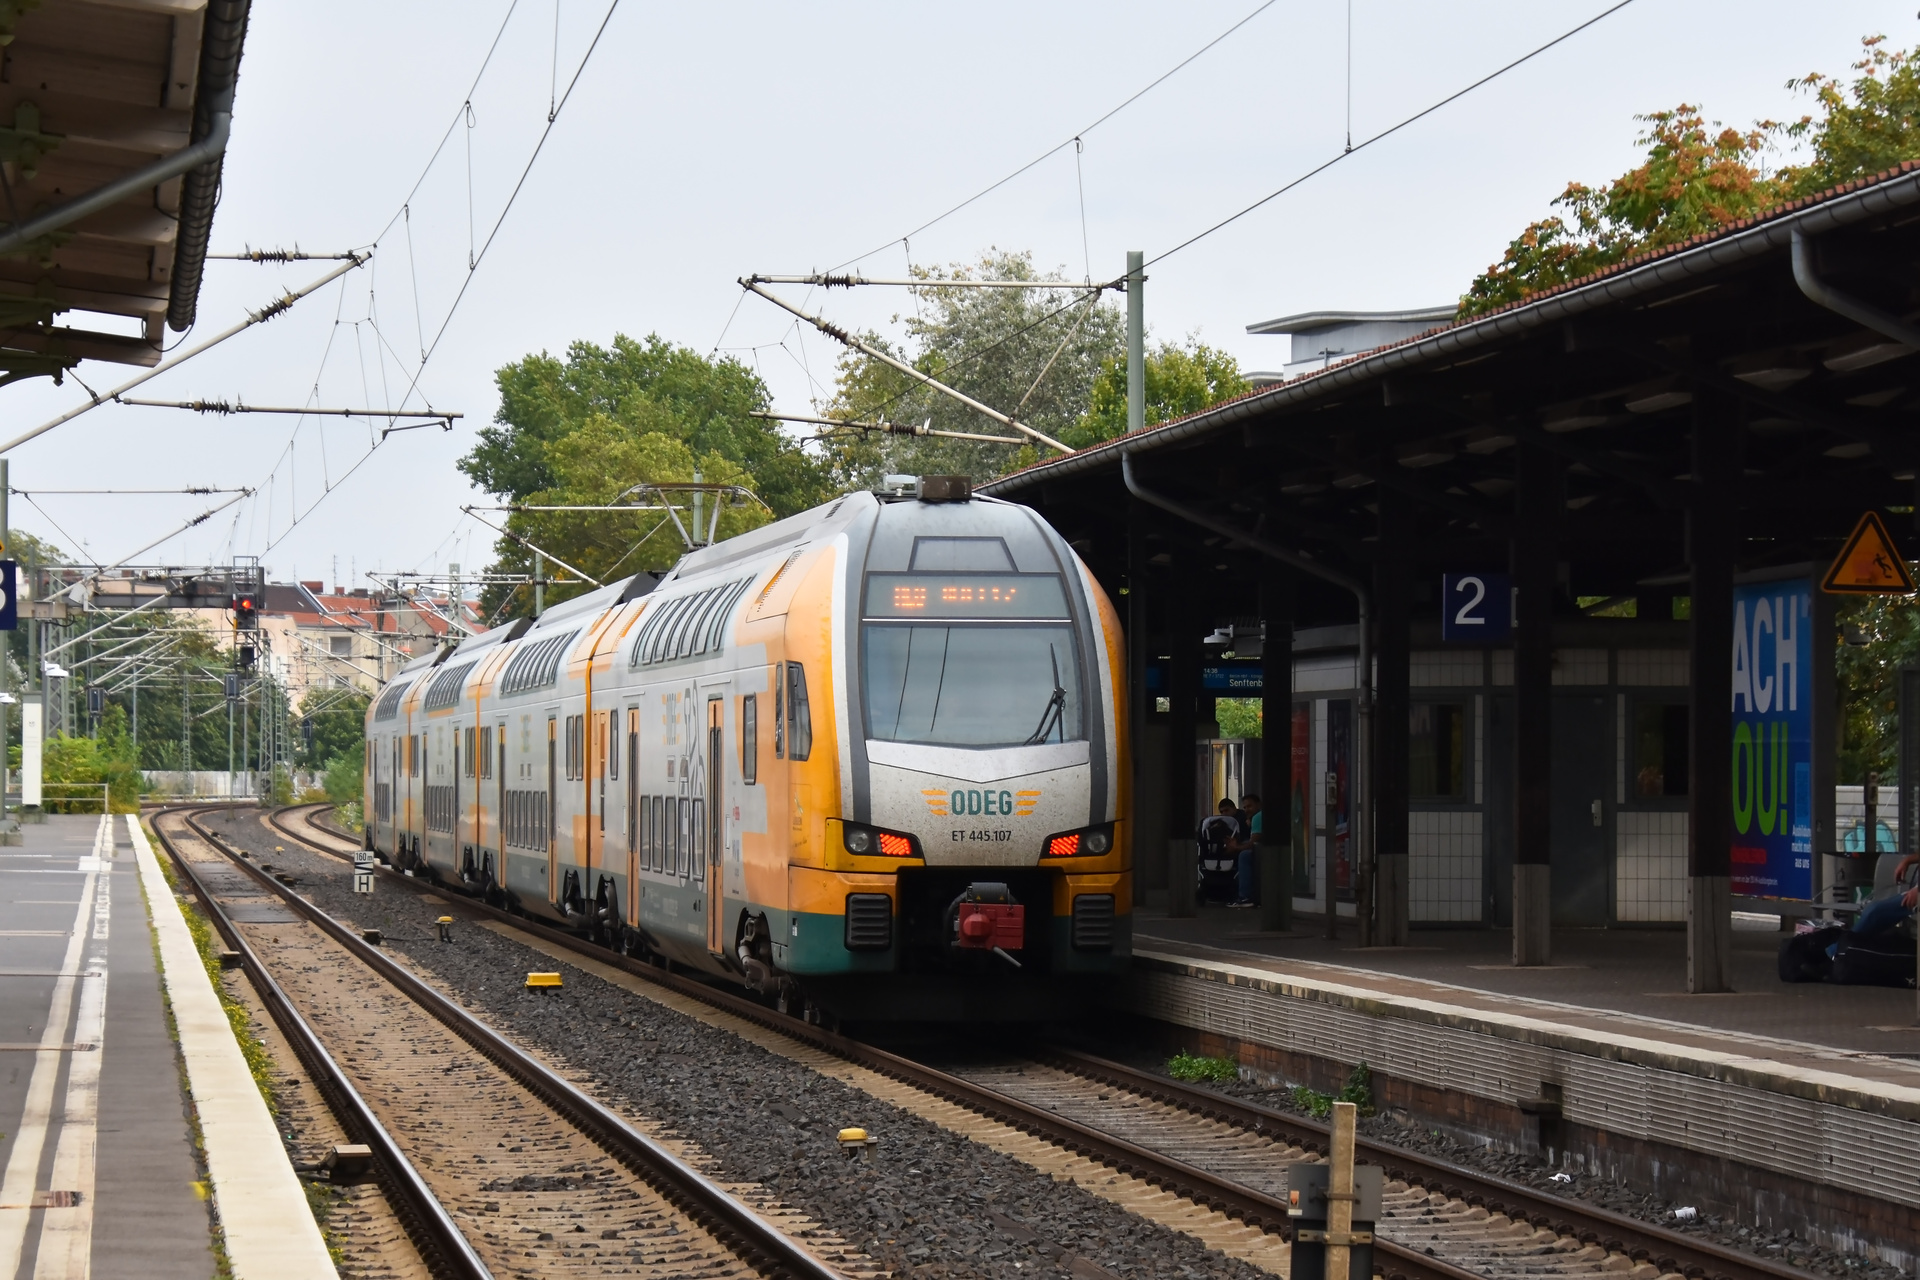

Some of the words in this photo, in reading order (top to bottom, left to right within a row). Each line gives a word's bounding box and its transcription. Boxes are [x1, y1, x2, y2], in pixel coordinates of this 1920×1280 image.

[1455, 576, 1486, 625] 2
[951, 790, 1013, 816] ODEG
[952, 830, 966, 842] ET
[969, 830, 1012, 842] 445.107
[355, 852, 367, 861] 160
[358, 875, 369, 892] H
